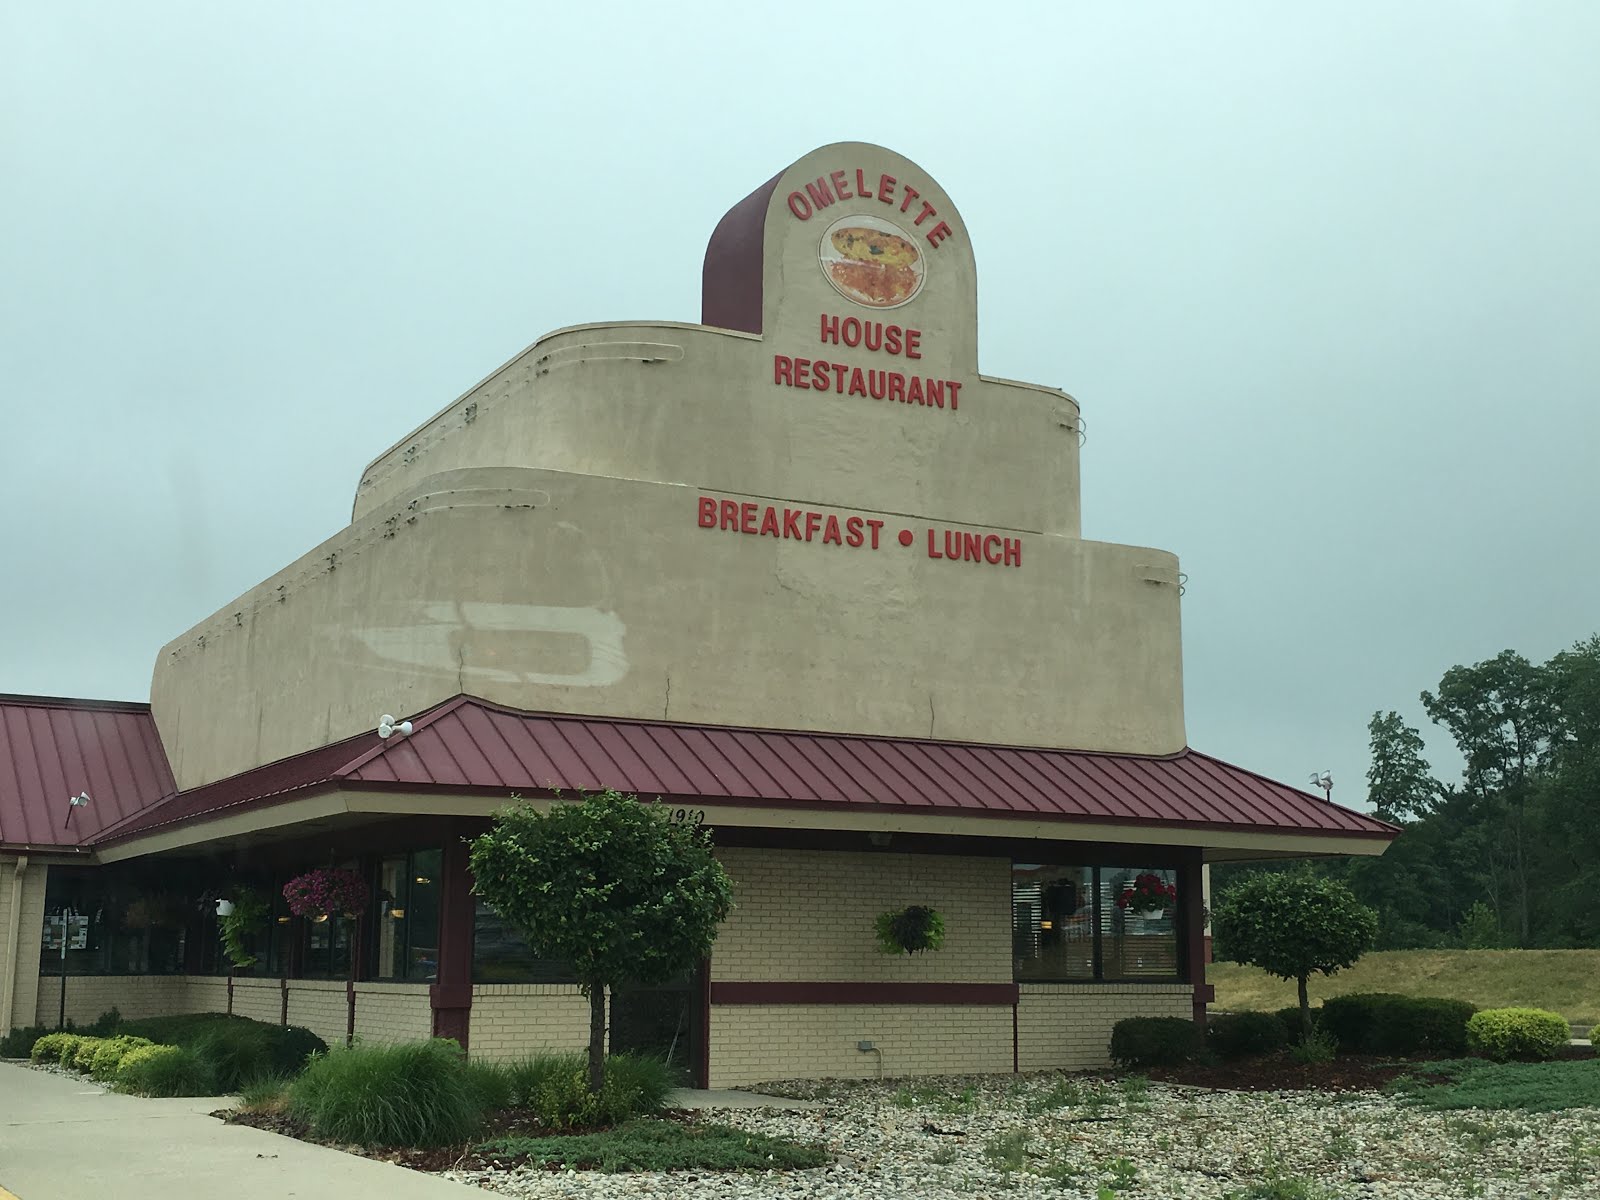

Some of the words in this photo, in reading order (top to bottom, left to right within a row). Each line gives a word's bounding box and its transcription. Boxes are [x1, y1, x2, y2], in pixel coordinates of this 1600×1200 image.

[787, 168, 952, 249] OMELETTE
[820, 314, 922, 359] HOUSE
[774, 354, 963, 410] RESTAURANT
[698, 496, 884, 550] BREAKFAST
[927, 528, 1022, 567] LUNCH
